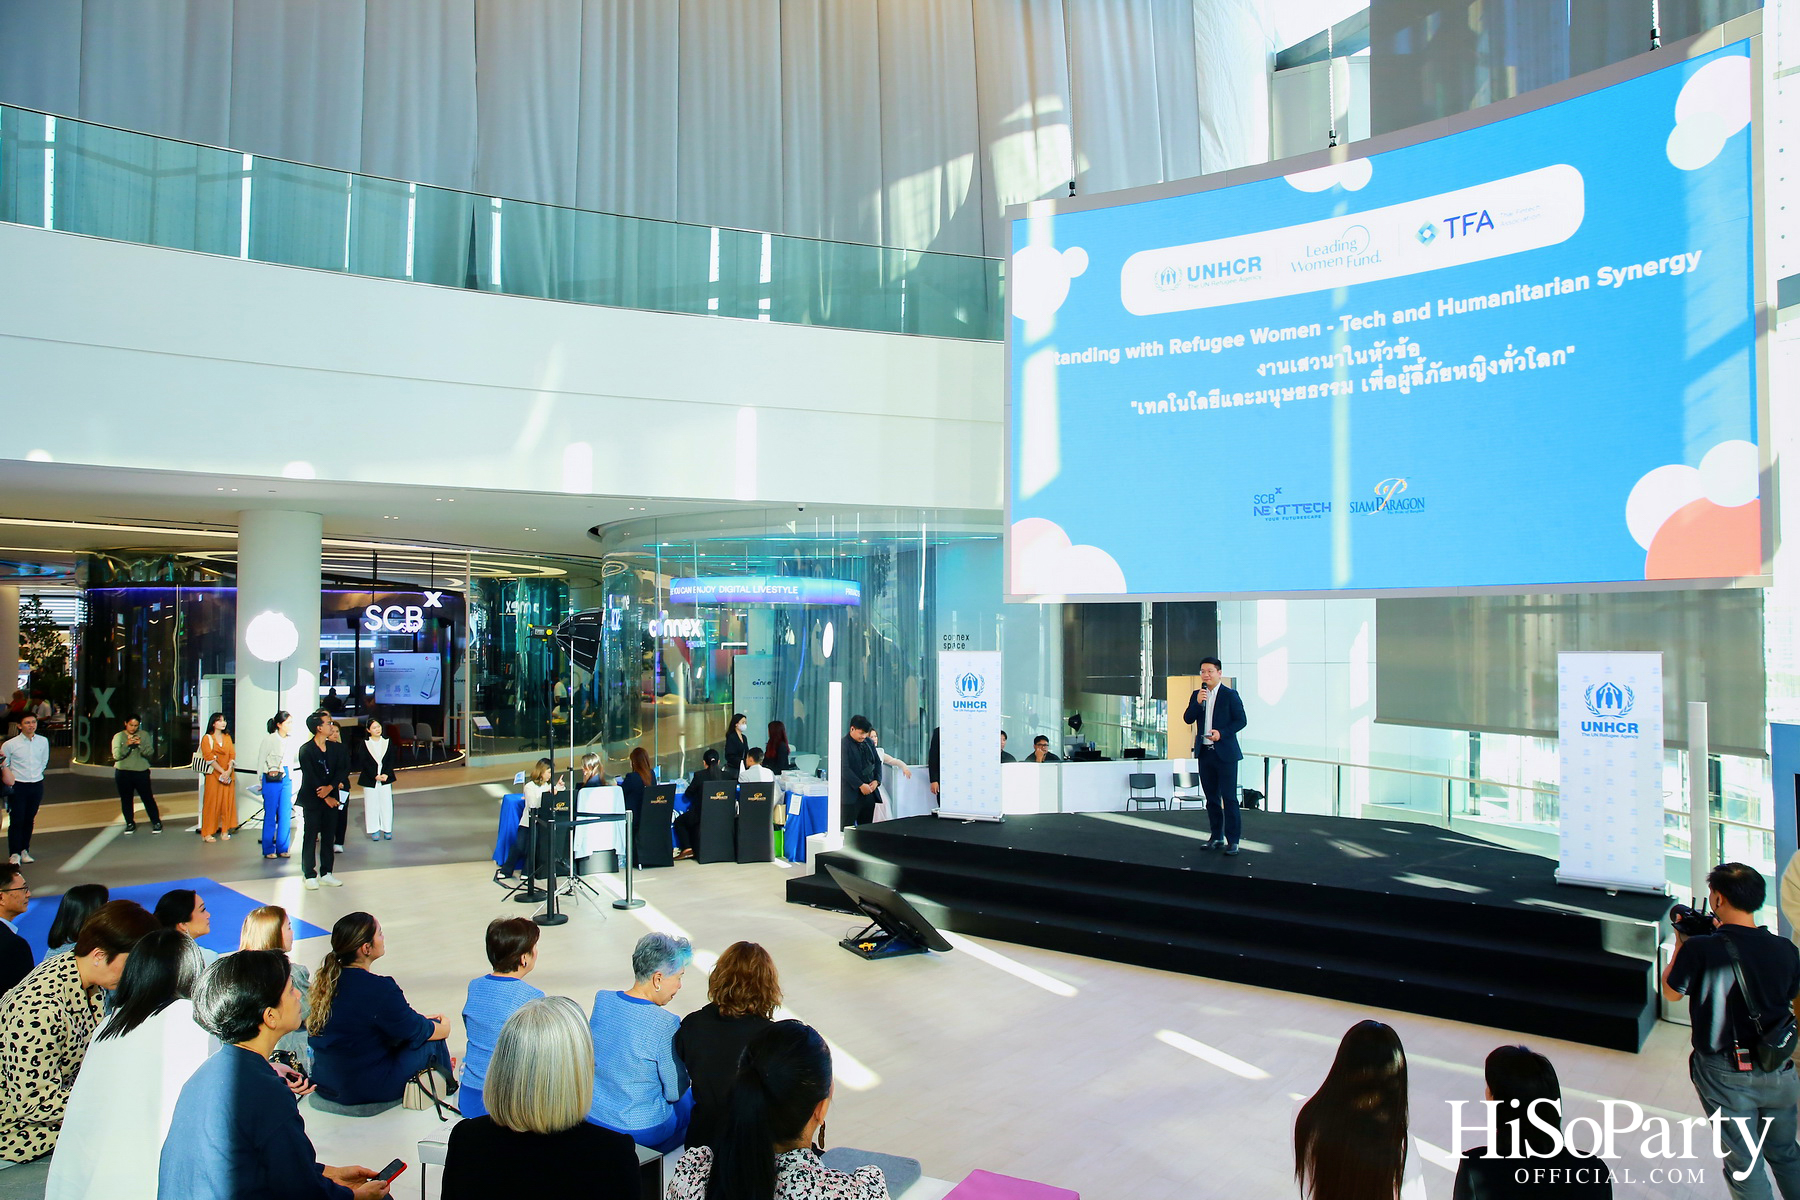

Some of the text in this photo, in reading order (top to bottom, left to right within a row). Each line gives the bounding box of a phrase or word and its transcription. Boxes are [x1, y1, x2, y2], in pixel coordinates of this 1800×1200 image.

[1443, 209, 1494, 239] TFA
[1306, 239, 1358, 258] Leading
[1187, 255, 1262, 282] UNHCR
[1291, 249, 1382, 273] Women Fund.
[1051, 346, 1120, 366] tanding
[1125, 340, 1163, 359] with
[1169, 332, 1245, 354] Refugee
[1250, 321, 1321, 345] Women
[1339, 310, 1386, 332] Tech
[1392, 302, 1431, 325] and
[1437, 274, 1590, 317] Humanitarian
[1596, 249, 1703, 289] Synergy
[1256, 336, 1421, 377] งานเสวนาในหัวข้อ
[1349, 501, 1375, 514] SIAM
[693, 585, 716, 594] ENJOY
[718, 585, 751, 594] DIGITAL
[752, 585, 799, 594] LIVESTYLE
[953, 701, 987, 709] UNHCR
[1581, 721, 1639, 733] UNHCR
